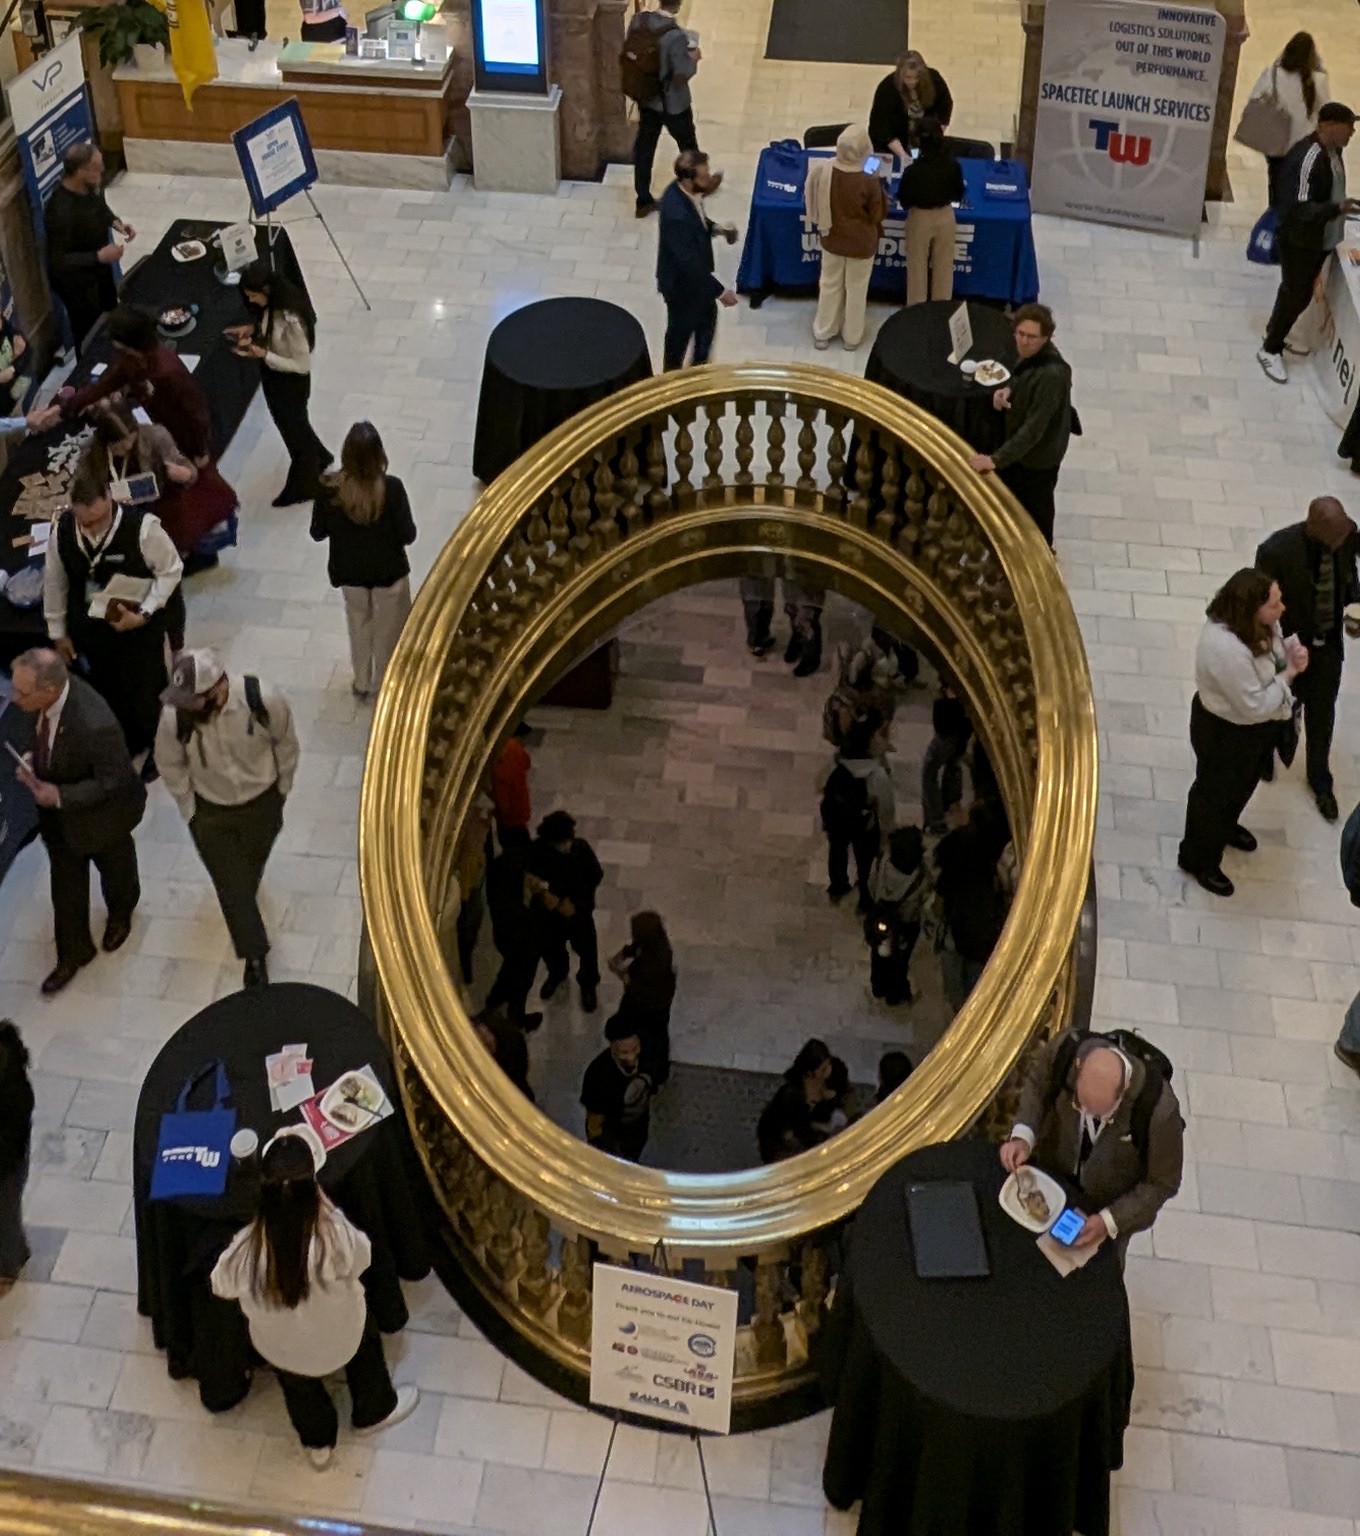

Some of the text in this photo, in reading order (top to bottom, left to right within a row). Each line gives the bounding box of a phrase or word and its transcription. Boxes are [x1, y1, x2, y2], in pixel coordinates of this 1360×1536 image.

[1157, 8, 1217, 27] INNOVATIVE
[1109, 21, 1213, 45] LOGISTICS SOLUTIONS.
[1115, 40, 1211, 63] OUT OF THIS WORLD
[32, 60, 63, 92] VP
[1136, 62, 1208, 82] PERFORMANCE.
[1041, 82, 1211, 122] SPACETEC LAUNCH SERVICES
[1089, 119, 1152, 166] TW
[691, 1298, 715, 1311] DAY
